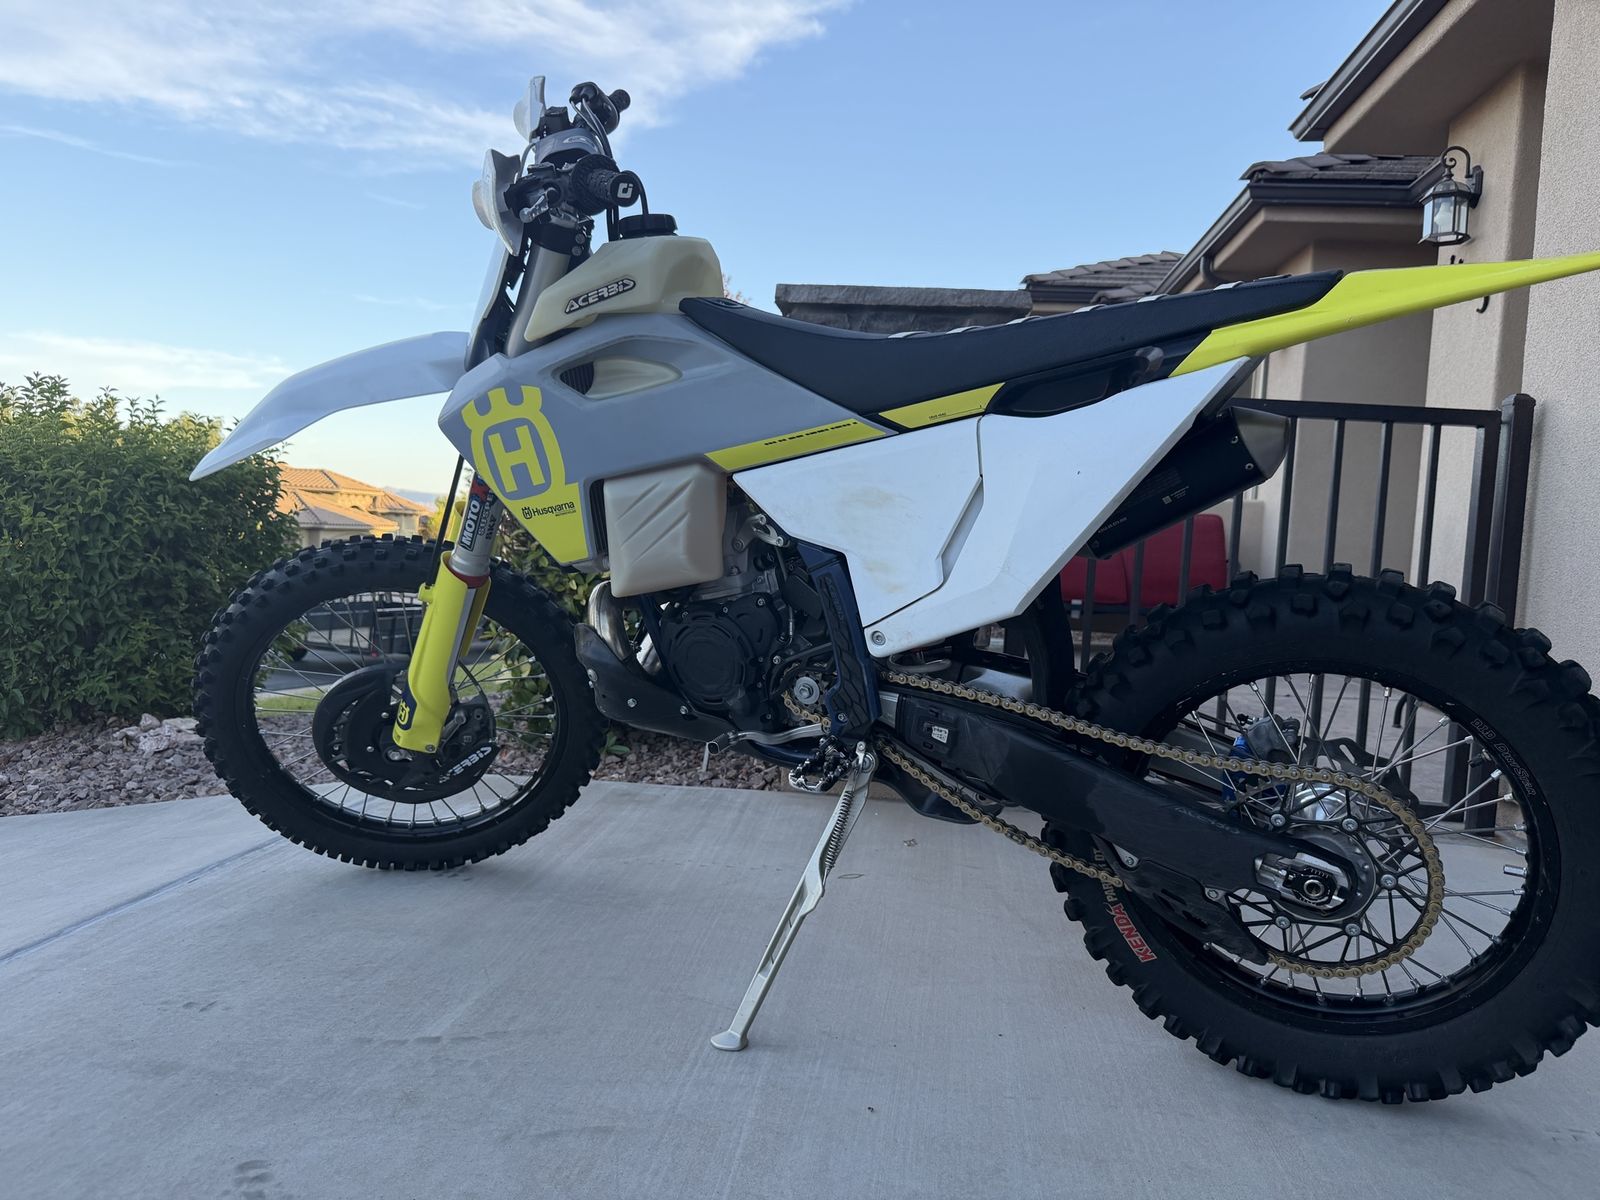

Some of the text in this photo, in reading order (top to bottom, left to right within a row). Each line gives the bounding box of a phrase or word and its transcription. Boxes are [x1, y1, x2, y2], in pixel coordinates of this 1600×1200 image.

[565, 278, 636, 314] ACERBIS
[461, 499, 482, 547] MOTO
[532, 501, 576, 517] Husqvarna
[1103, 902, 1158, 963] KENDA
